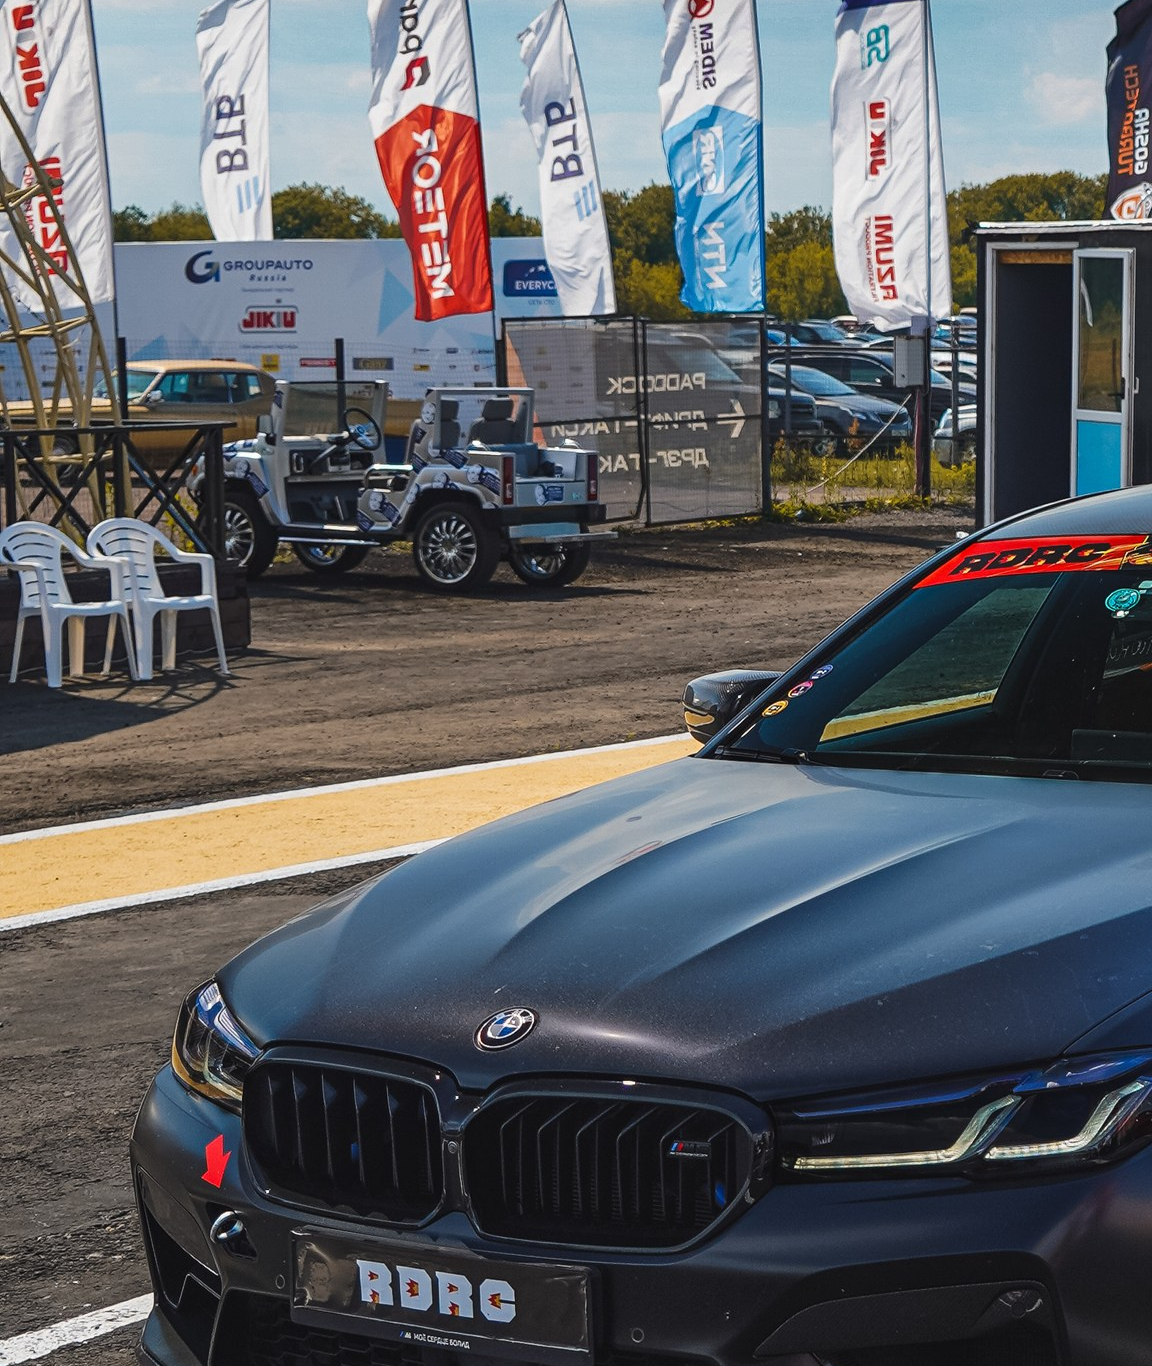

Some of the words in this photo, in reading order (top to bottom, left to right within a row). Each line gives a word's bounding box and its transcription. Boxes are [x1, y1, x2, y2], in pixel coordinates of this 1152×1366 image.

[223, 260, 314, 271] GROUPAUTO
[249, 274, 287, 282] Russia
[514, 280, 557, 290] EVERYC
[242, 311, 297, 329] JIKIU
[948, 542, 1113, 576] RDRC
[356, 1259, 517, 1324] RDRC
